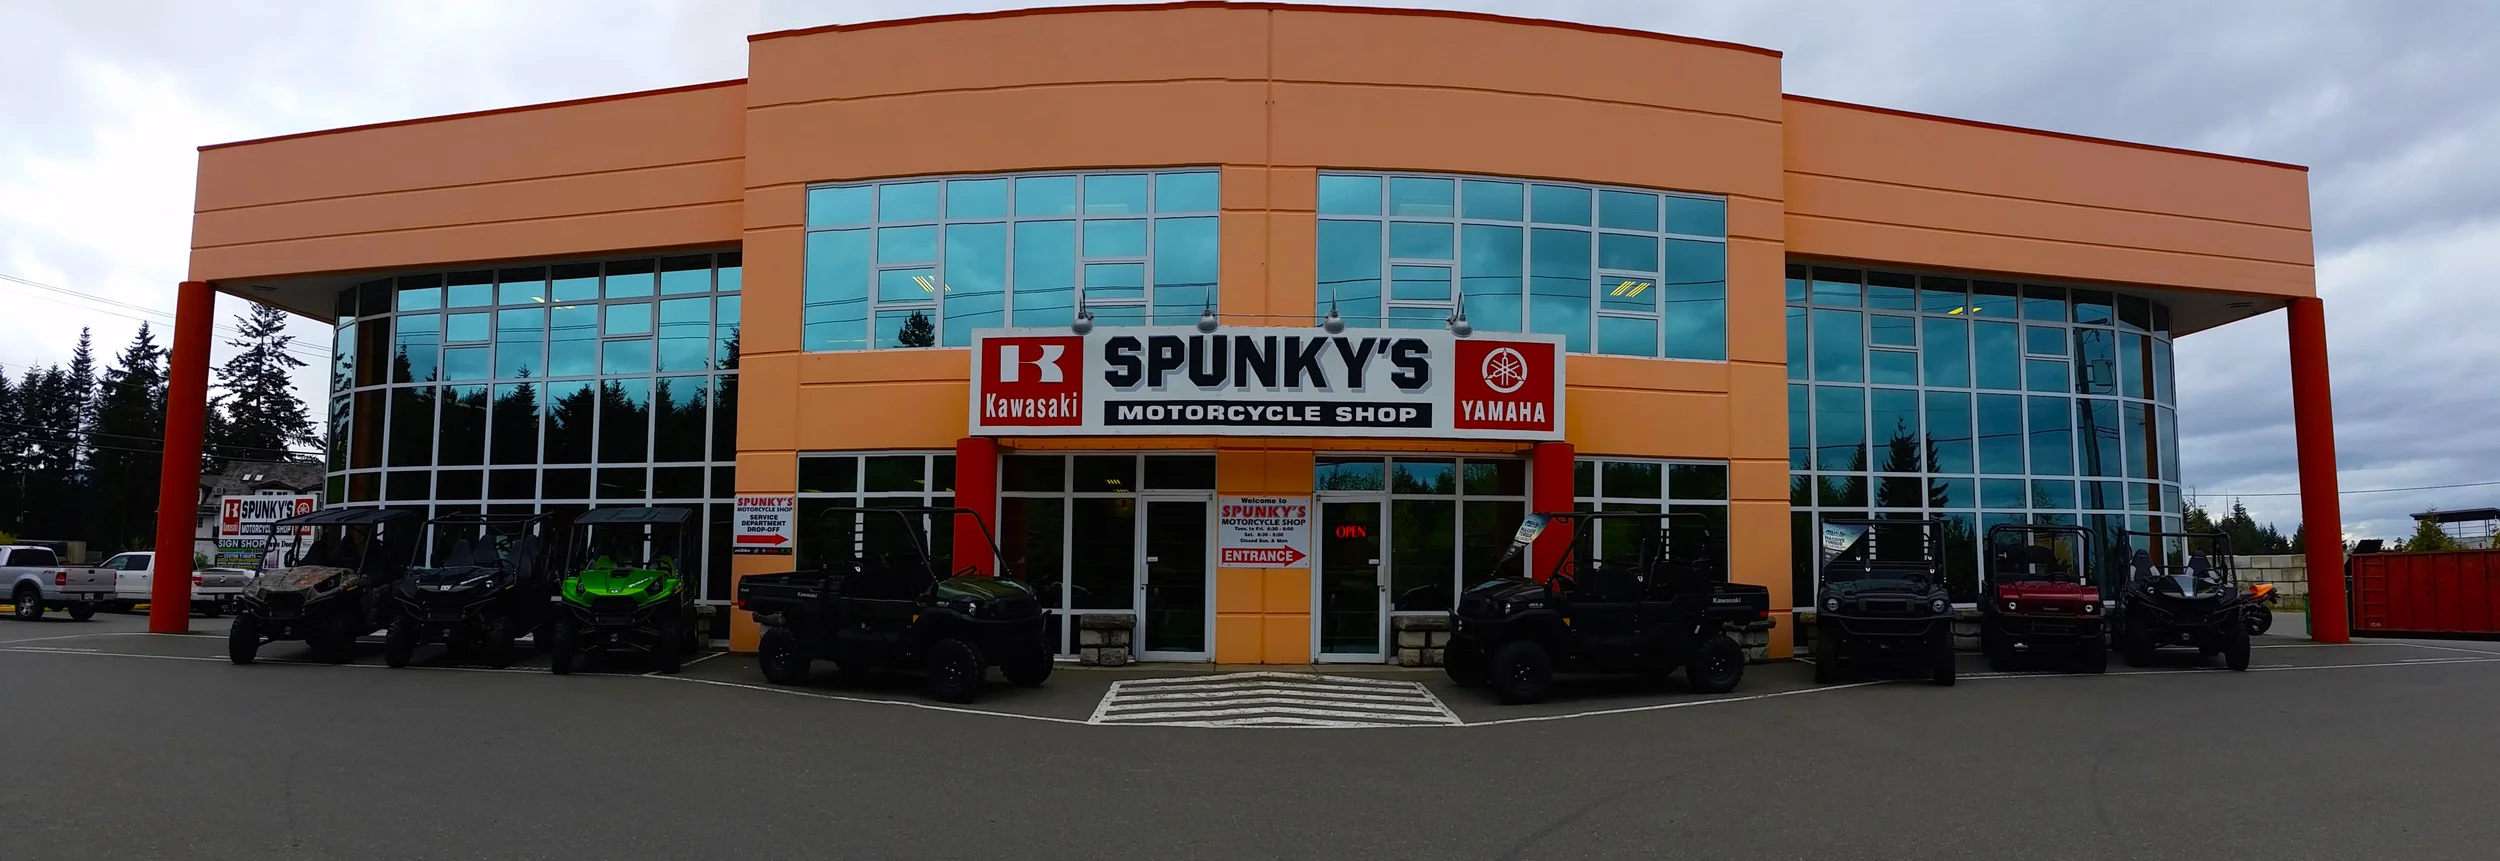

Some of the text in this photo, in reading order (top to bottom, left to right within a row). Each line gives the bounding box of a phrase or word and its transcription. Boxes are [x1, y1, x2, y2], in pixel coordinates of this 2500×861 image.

[1104, 335, 1431, 392] SPUNKY'S
[985, 393, 1077, 418] Kawasaki
[1462, 400, 1545, 424] YAMAHA
[1118, 404, 1417, 423] MOTORCYCLE SHOP
[737, 497, 793, 506] SPUNKY'S
[242, 501, 293, 518] SPUNKY'S
[1222, 505, 1306, 518] SPUNKY'S
[242, 524, 273, 533] MOTORCYCL
[276, 525, 291, 534] SHOP
[1336, 525, 1366, 538] OPEN
[218, 540, 239, 548] SIGN
[240, 540, 264, 548] SHOP
[1225, 550, 1294, 562] ENTRANCE
